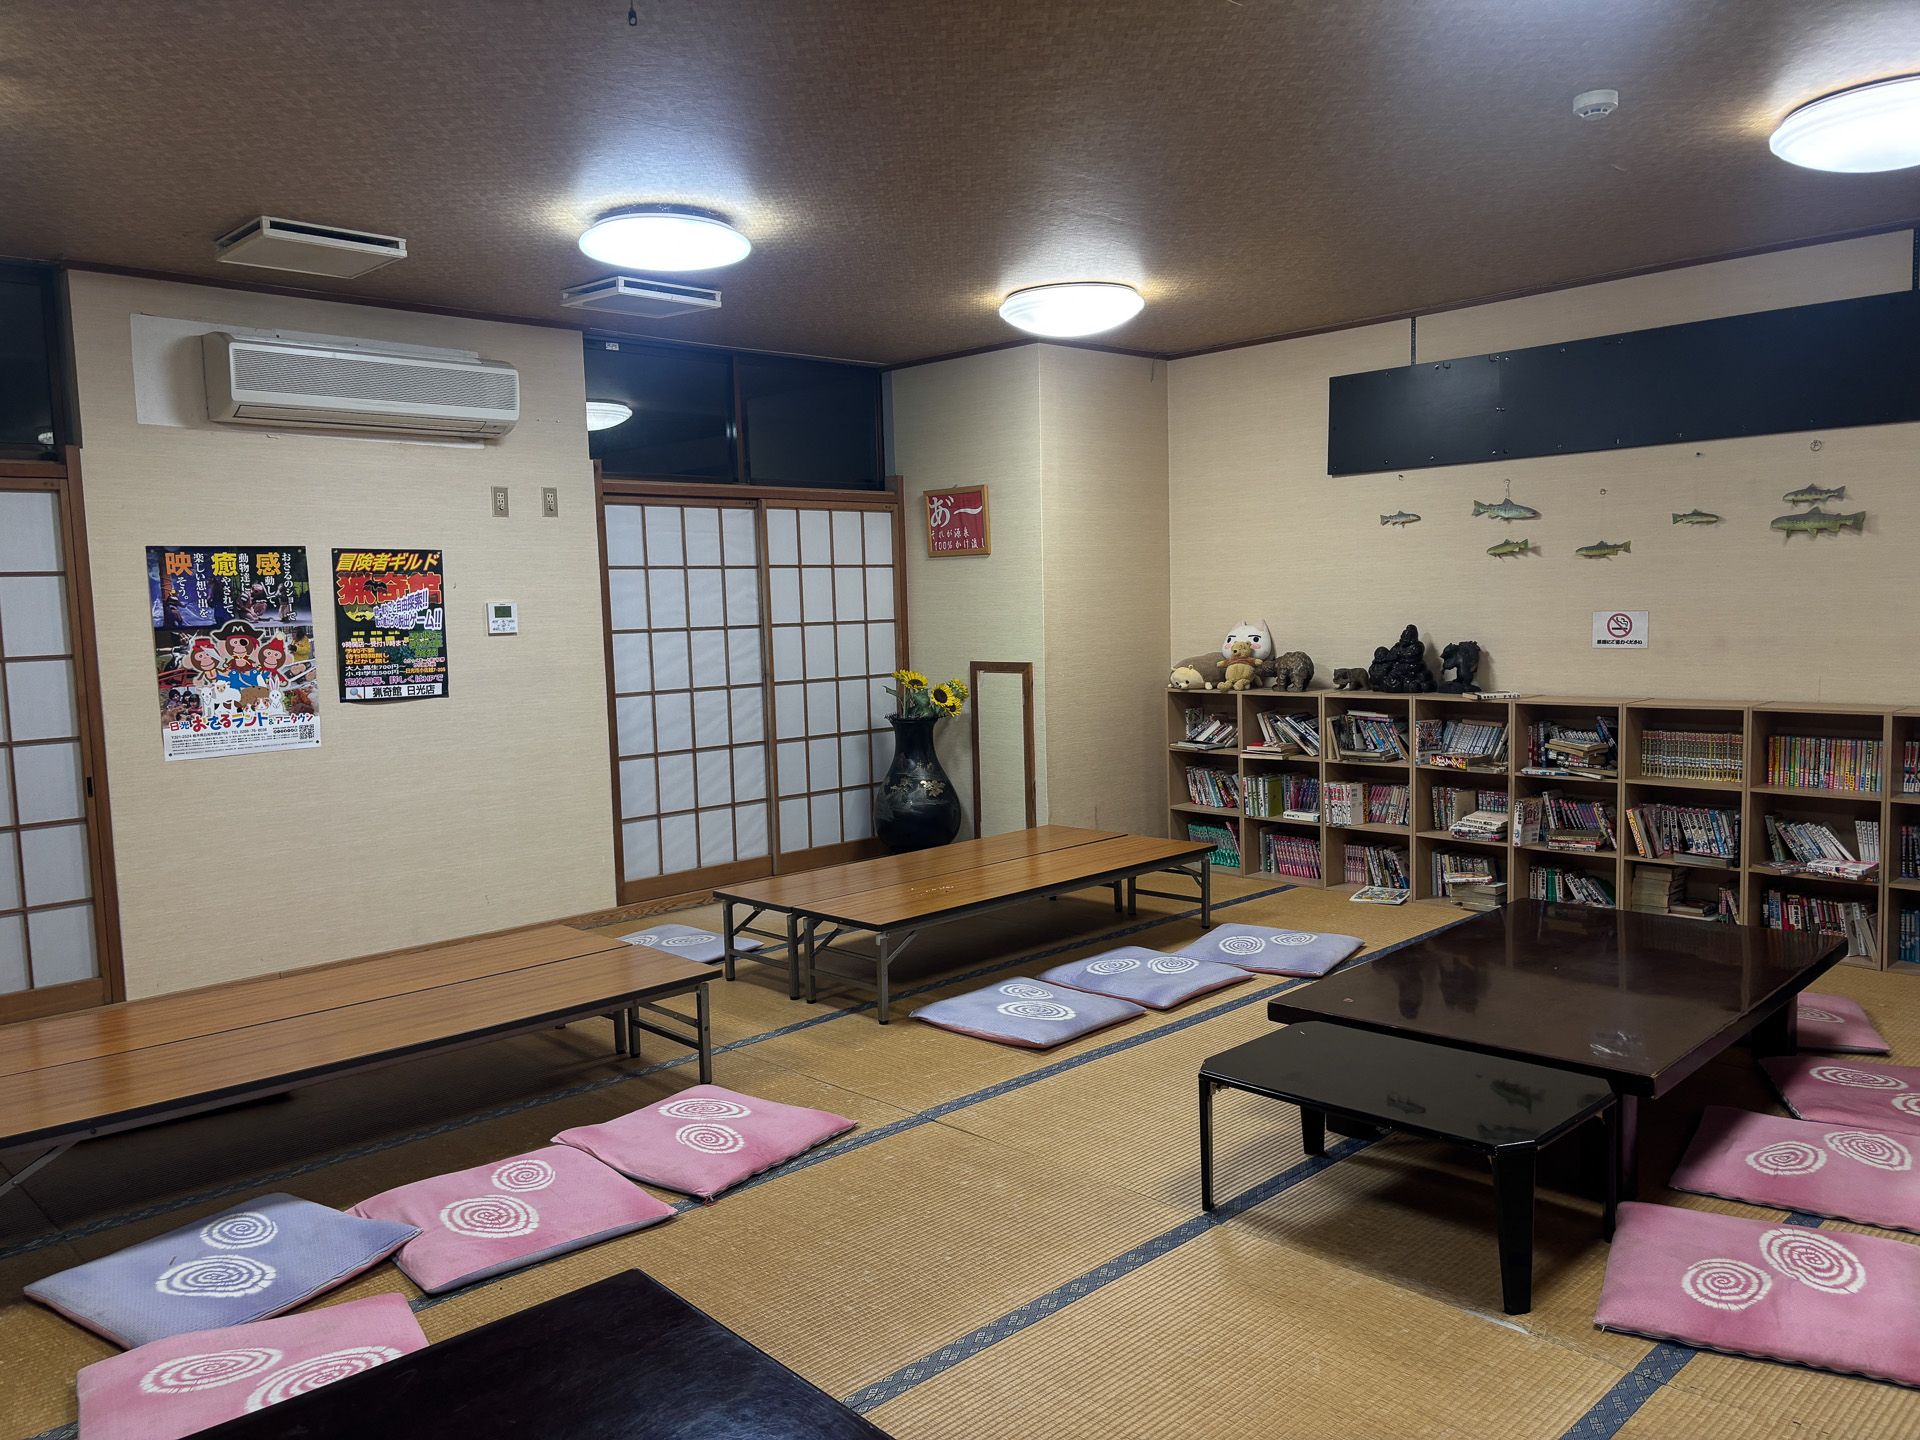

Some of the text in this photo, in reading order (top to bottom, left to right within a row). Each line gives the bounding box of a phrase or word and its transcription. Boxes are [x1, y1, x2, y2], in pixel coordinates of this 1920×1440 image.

[238, 552, 251, 592] 動物達に
[336, 553, 440, 572] 冒険者ギルド
[193, 552, 209, 618] 楽しい想い出を
[282, 552, 297, 621] おさるのショーで
[373, 685, 435, 697] 猟奇館 日光店
